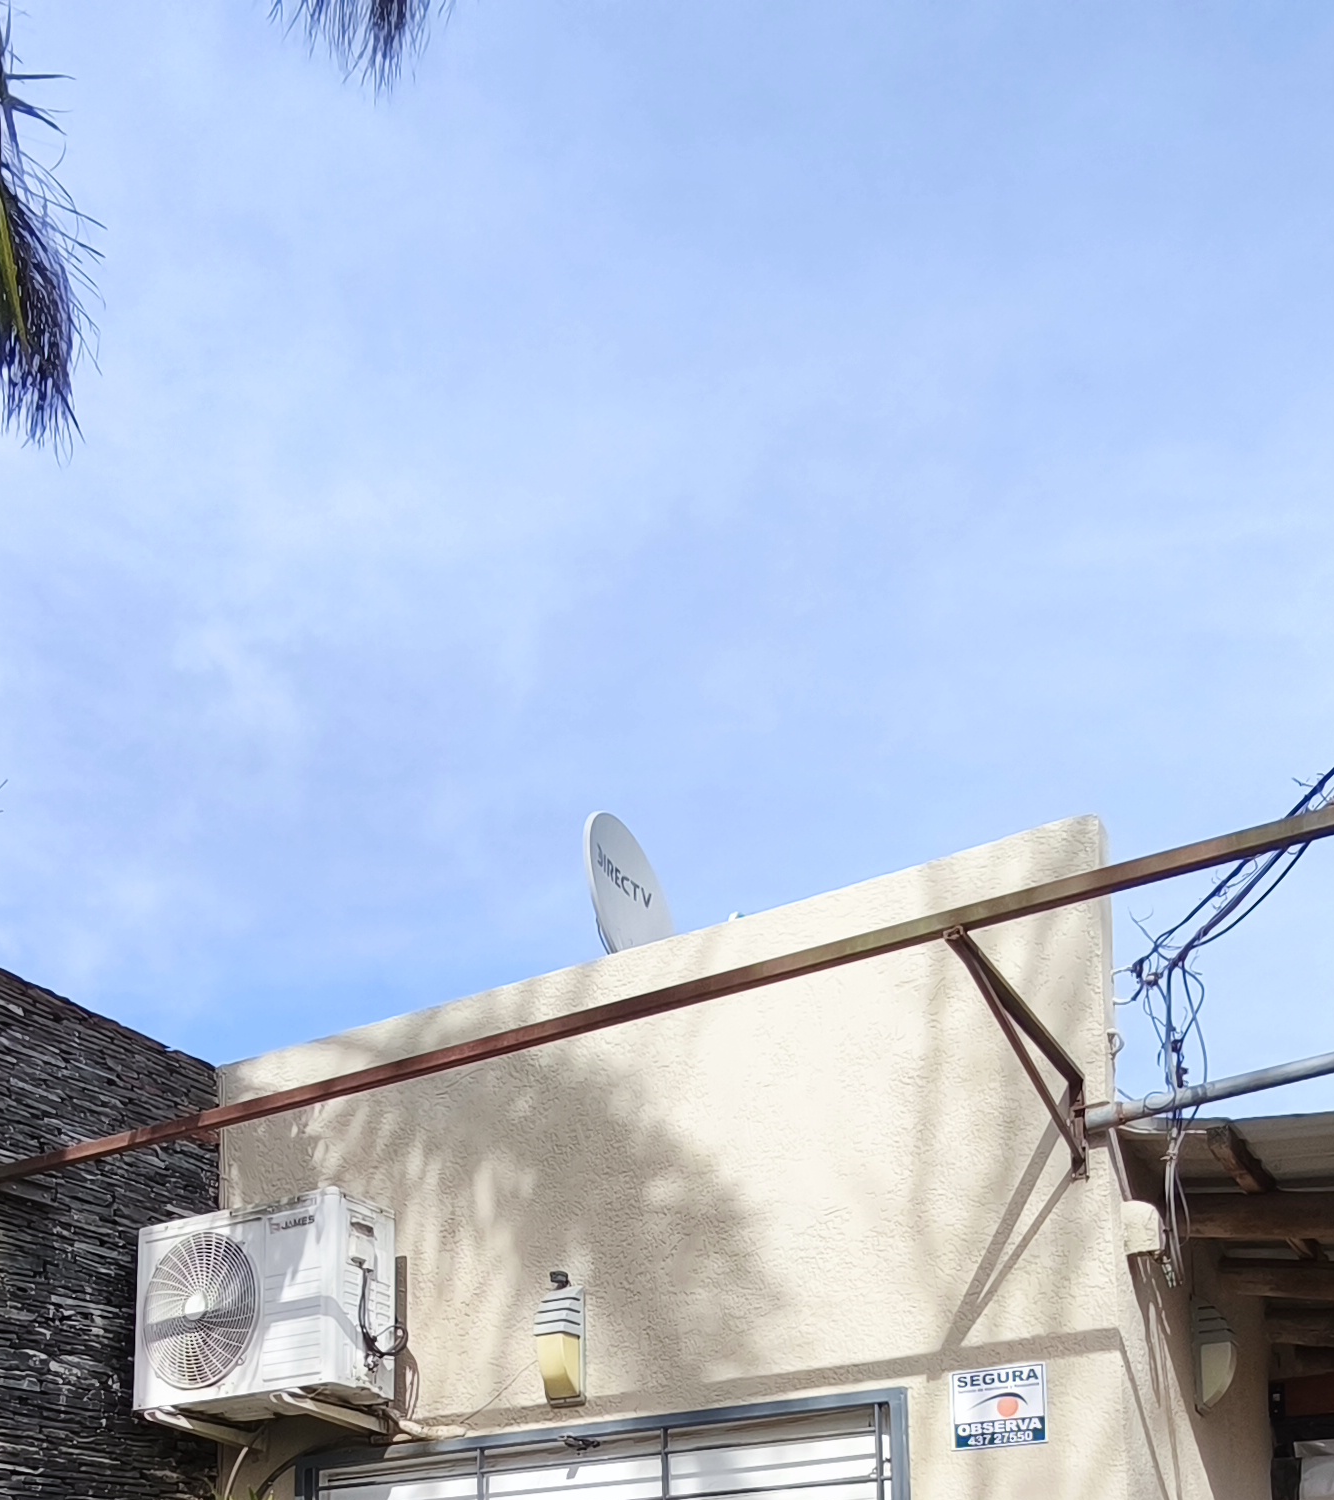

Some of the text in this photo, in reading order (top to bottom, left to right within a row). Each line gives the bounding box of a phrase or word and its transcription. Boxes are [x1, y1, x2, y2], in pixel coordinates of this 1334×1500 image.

[597, 843, 652, 908] DIRECTV
[281, 1215, 315, 1230] JAMES
[957, 1368, 1039, 1388] SEGURA
[957, 1418, 1042, 1436] OBSERVA
[967, 1434, 990, 1446] 437
